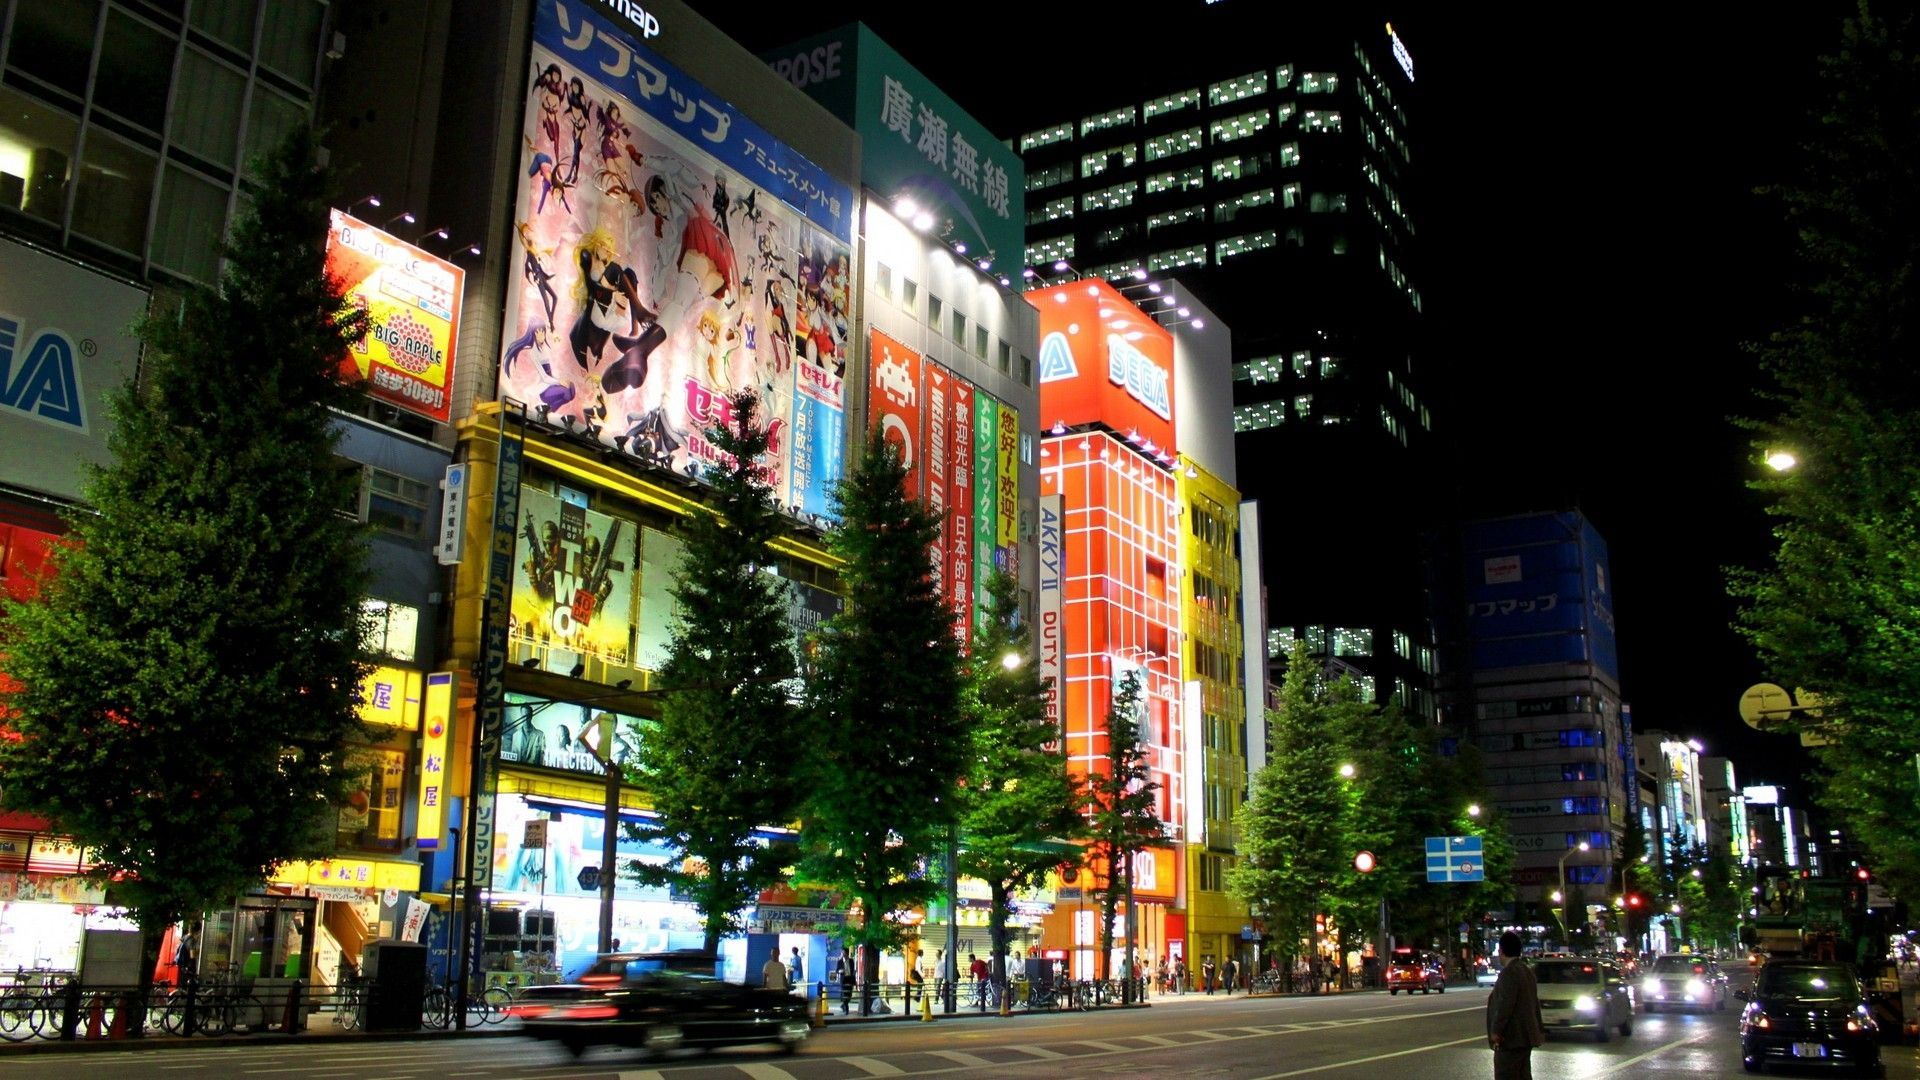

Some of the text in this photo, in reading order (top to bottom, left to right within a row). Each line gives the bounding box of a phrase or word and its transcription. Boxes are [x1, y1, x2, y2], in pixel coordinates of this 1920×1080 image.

[600, 0, 660, 39] map
[556, 3, 732, 144] ソフマップ
[743, 138, 841, 219] アミューズメント館
[375, 324, 442, 365] BIG APPLE
[1110, 335, 1170, 420] SEGA
[930, 386, 944, 481] WELCOME!
[1041, 507, 1058, 575] AKKY
[1043, 611, 1057, 667] DUTY
[423, 753, 442, 807] 松屋
[338, 866, 369, 882] 松屋
[473, 805, 492, 883] ソフマップ
